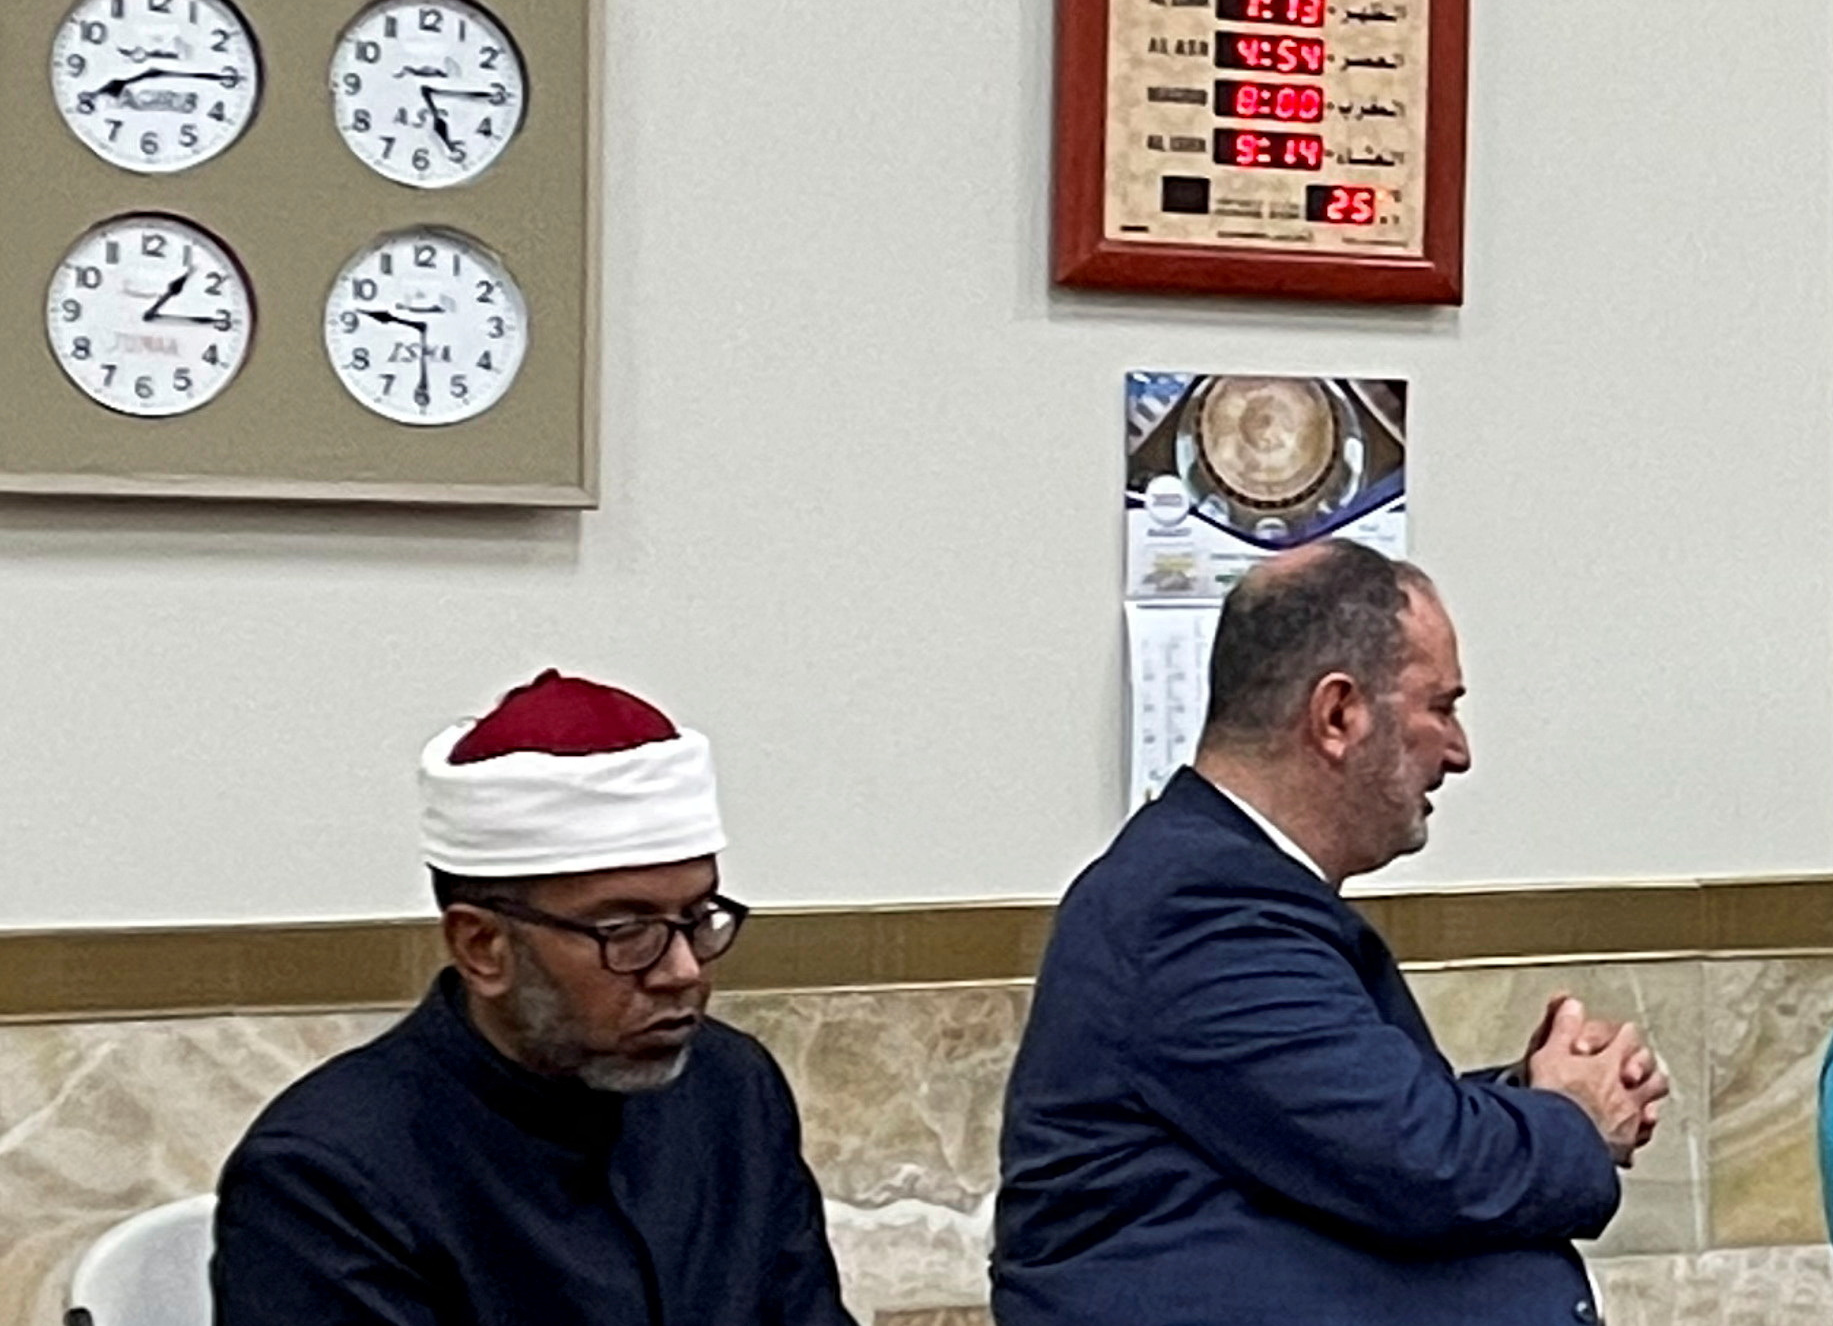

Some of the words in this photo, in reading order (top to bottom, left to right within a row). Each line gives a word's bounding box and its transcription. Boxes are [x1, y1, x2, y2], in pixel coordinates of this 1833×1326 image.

[1237, 40, 1322, 72] 4:54
[1236, 86, 1321, 119] 8:00
[1236, 134, 1320, 165] 9:14
[1327, 189, 1372, 221] 25
